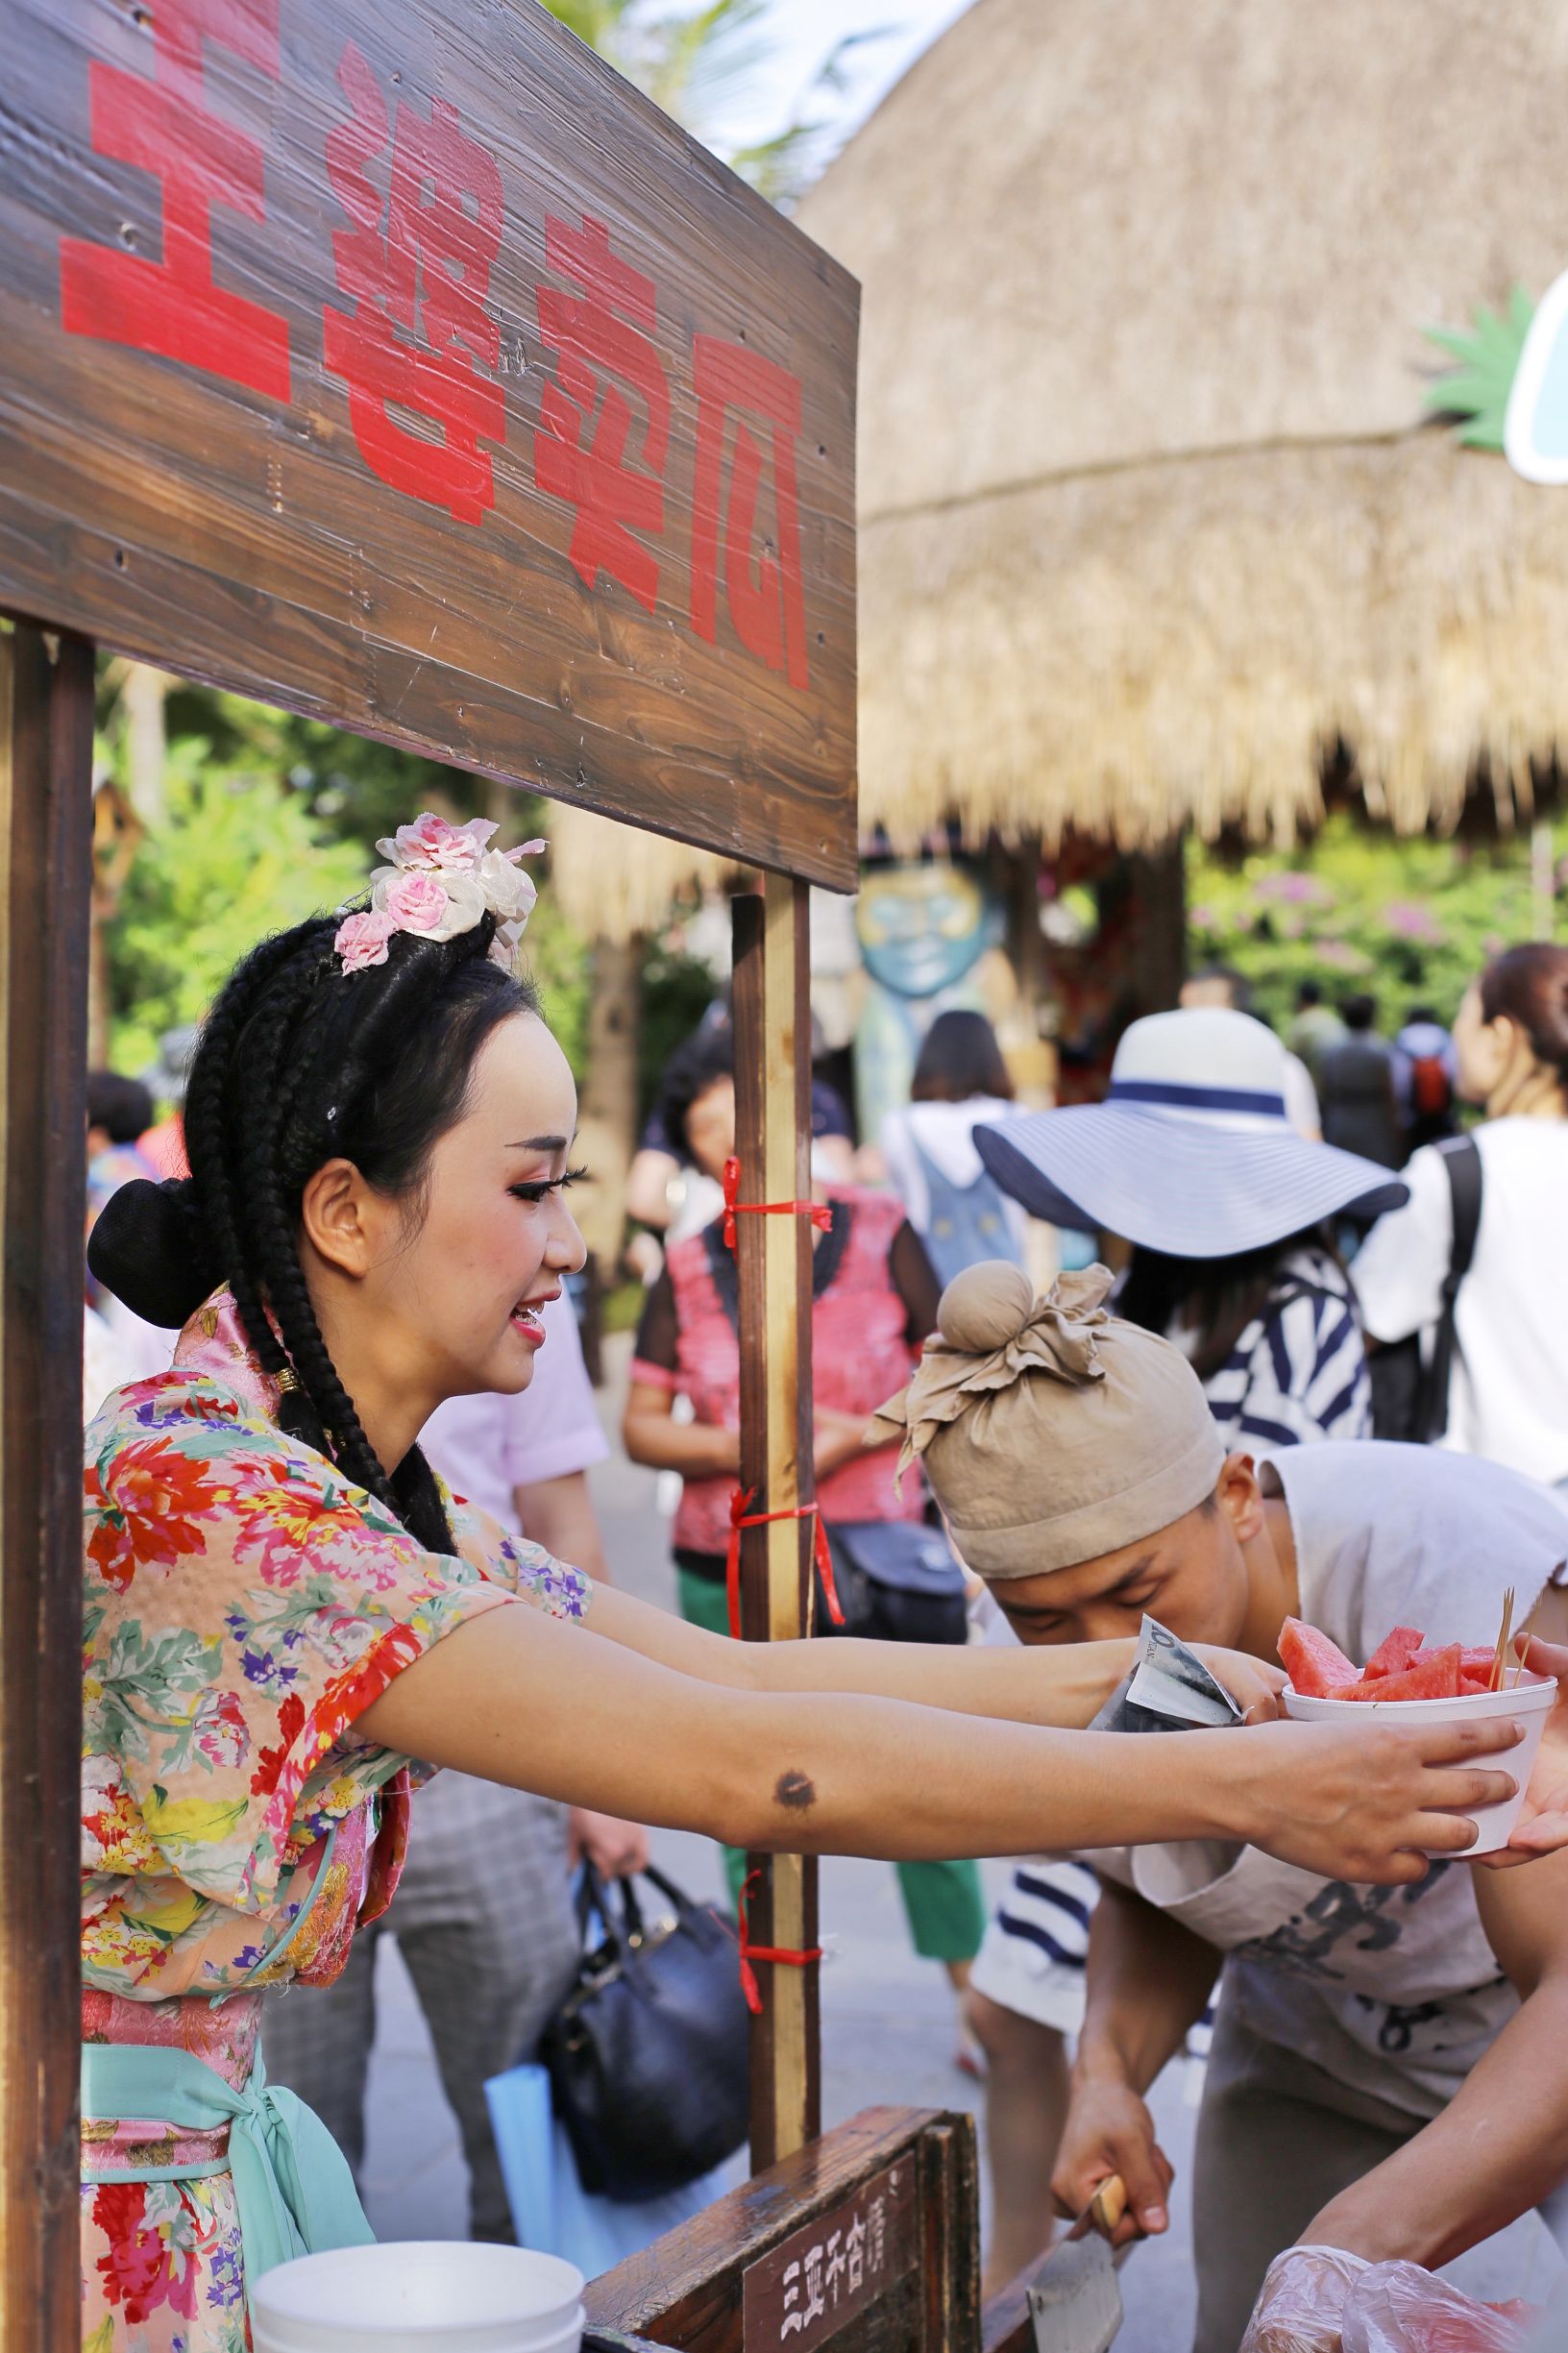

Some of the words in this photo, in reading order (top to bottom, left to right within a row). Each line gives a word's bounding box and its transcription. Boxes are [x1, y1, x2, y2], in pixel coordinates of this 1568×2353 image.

[60, 0, 809, 691] 王婆卖瓜
[1151, 1624, 1175, 1648] 10
